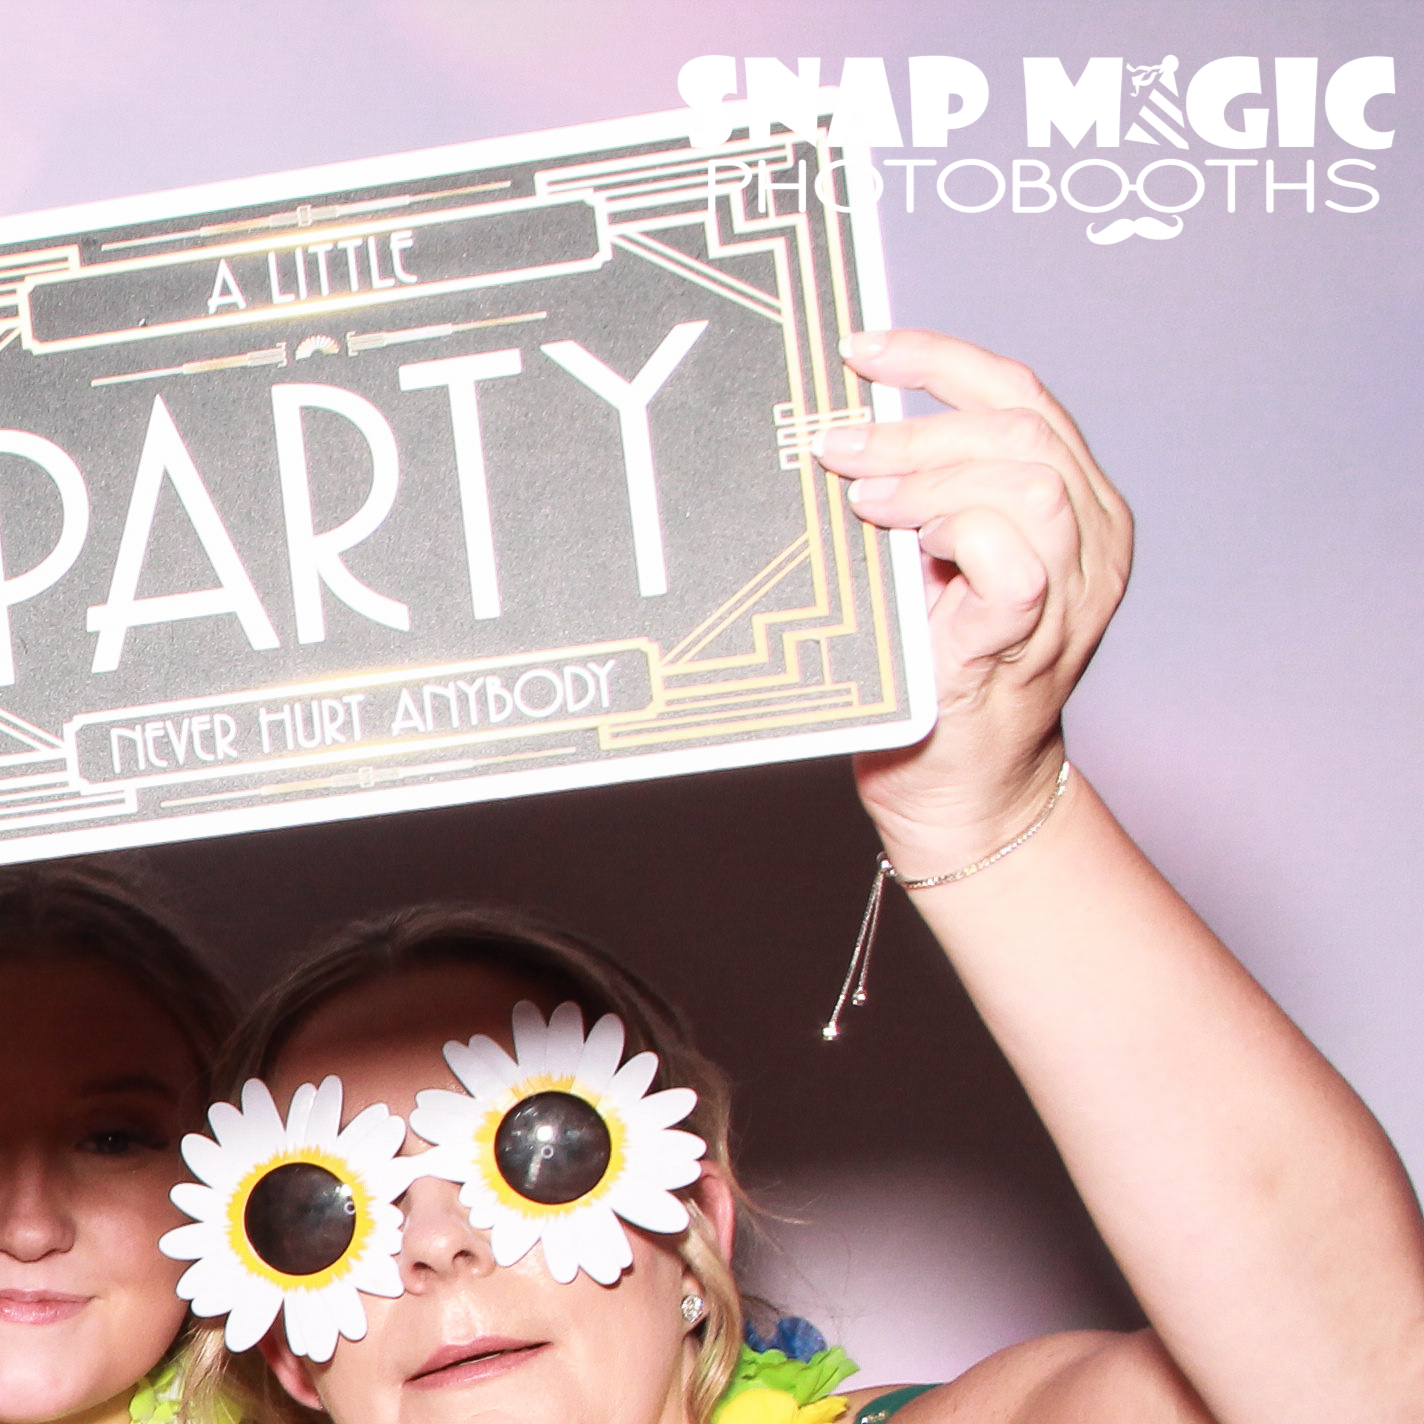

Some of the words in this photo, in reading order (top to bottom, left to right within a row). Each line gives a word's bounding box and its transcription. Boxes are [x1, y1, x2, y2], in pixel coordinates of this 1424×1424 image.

[208, 258, 246, 314] A
[268, 230, 417, 304] LITTLE
[109, 712, 238, 774] NEVER
[259, 694, 365, 753] HURT
[391, 659, 615, 737] ANYBODY
